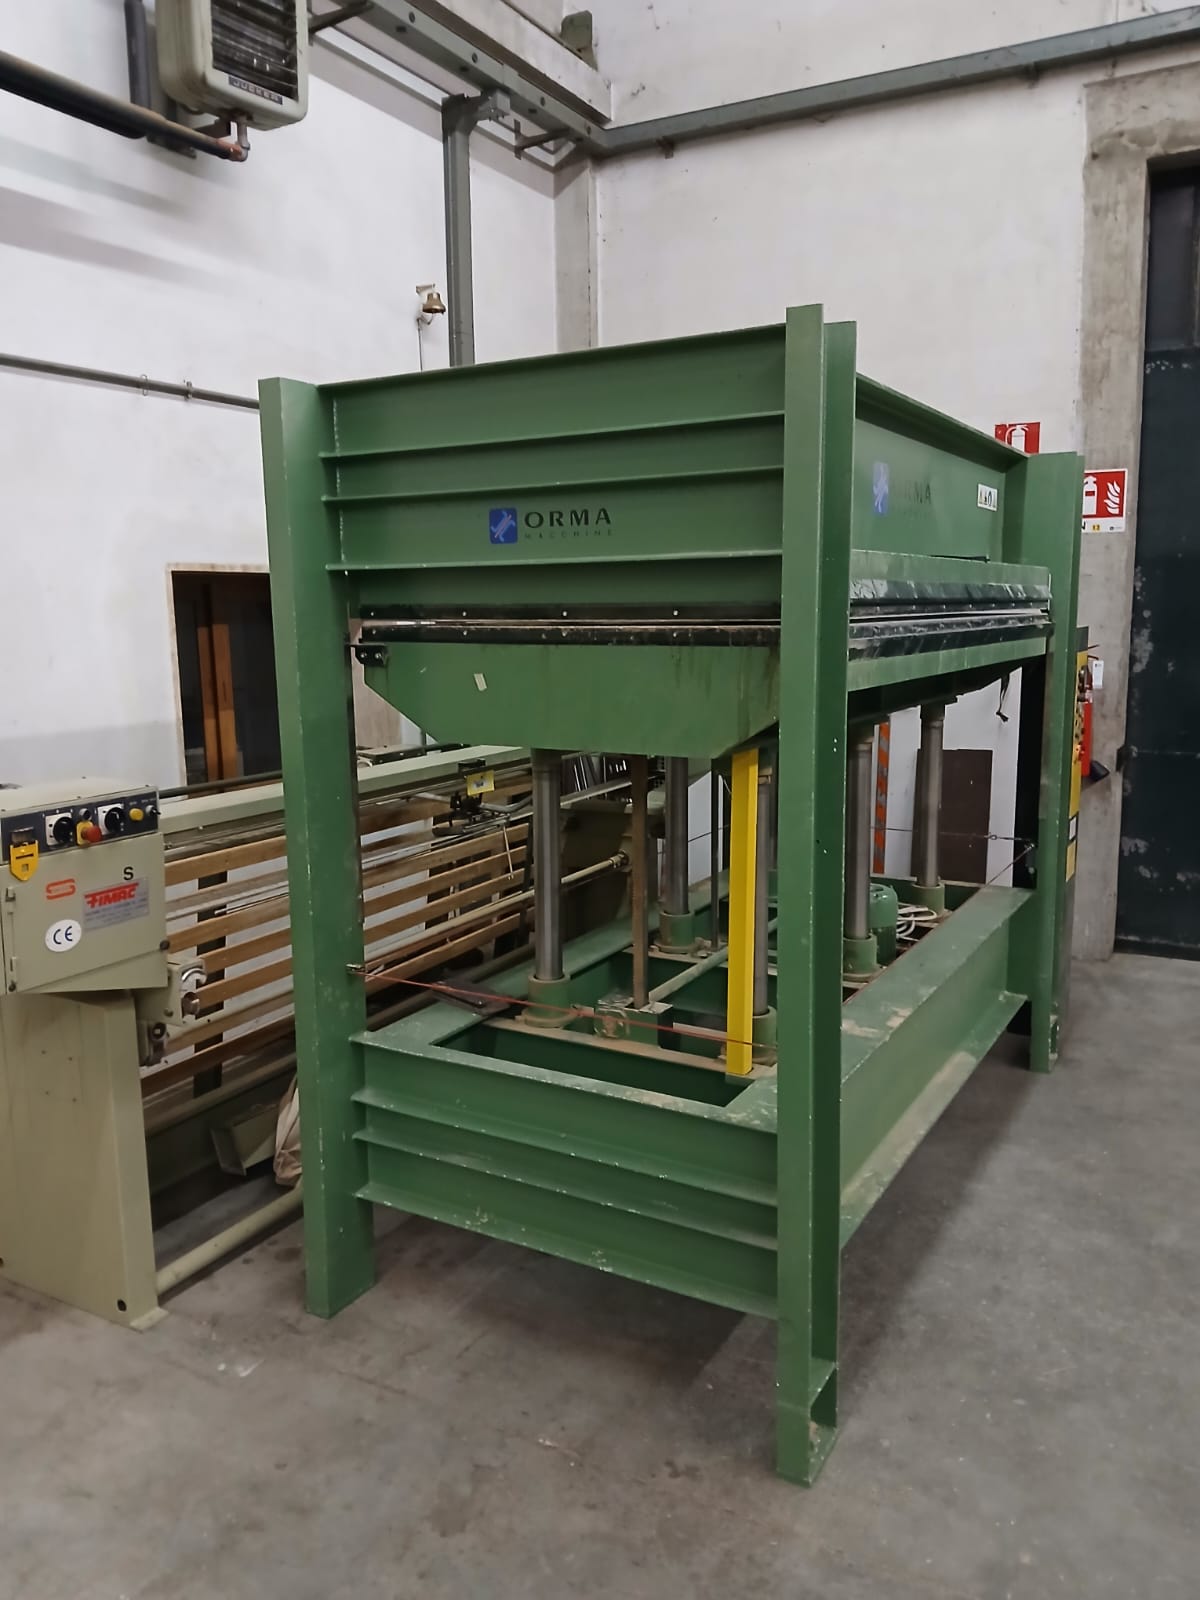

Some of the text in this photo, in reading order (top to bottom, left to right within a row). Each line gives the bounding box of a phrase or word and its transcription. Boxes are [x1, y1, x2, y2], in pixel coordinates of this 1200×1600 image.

[524, 507, 611, 529] ORMA
[123, 866, 134, 881] S
[53, 925, 73, 945] CE
